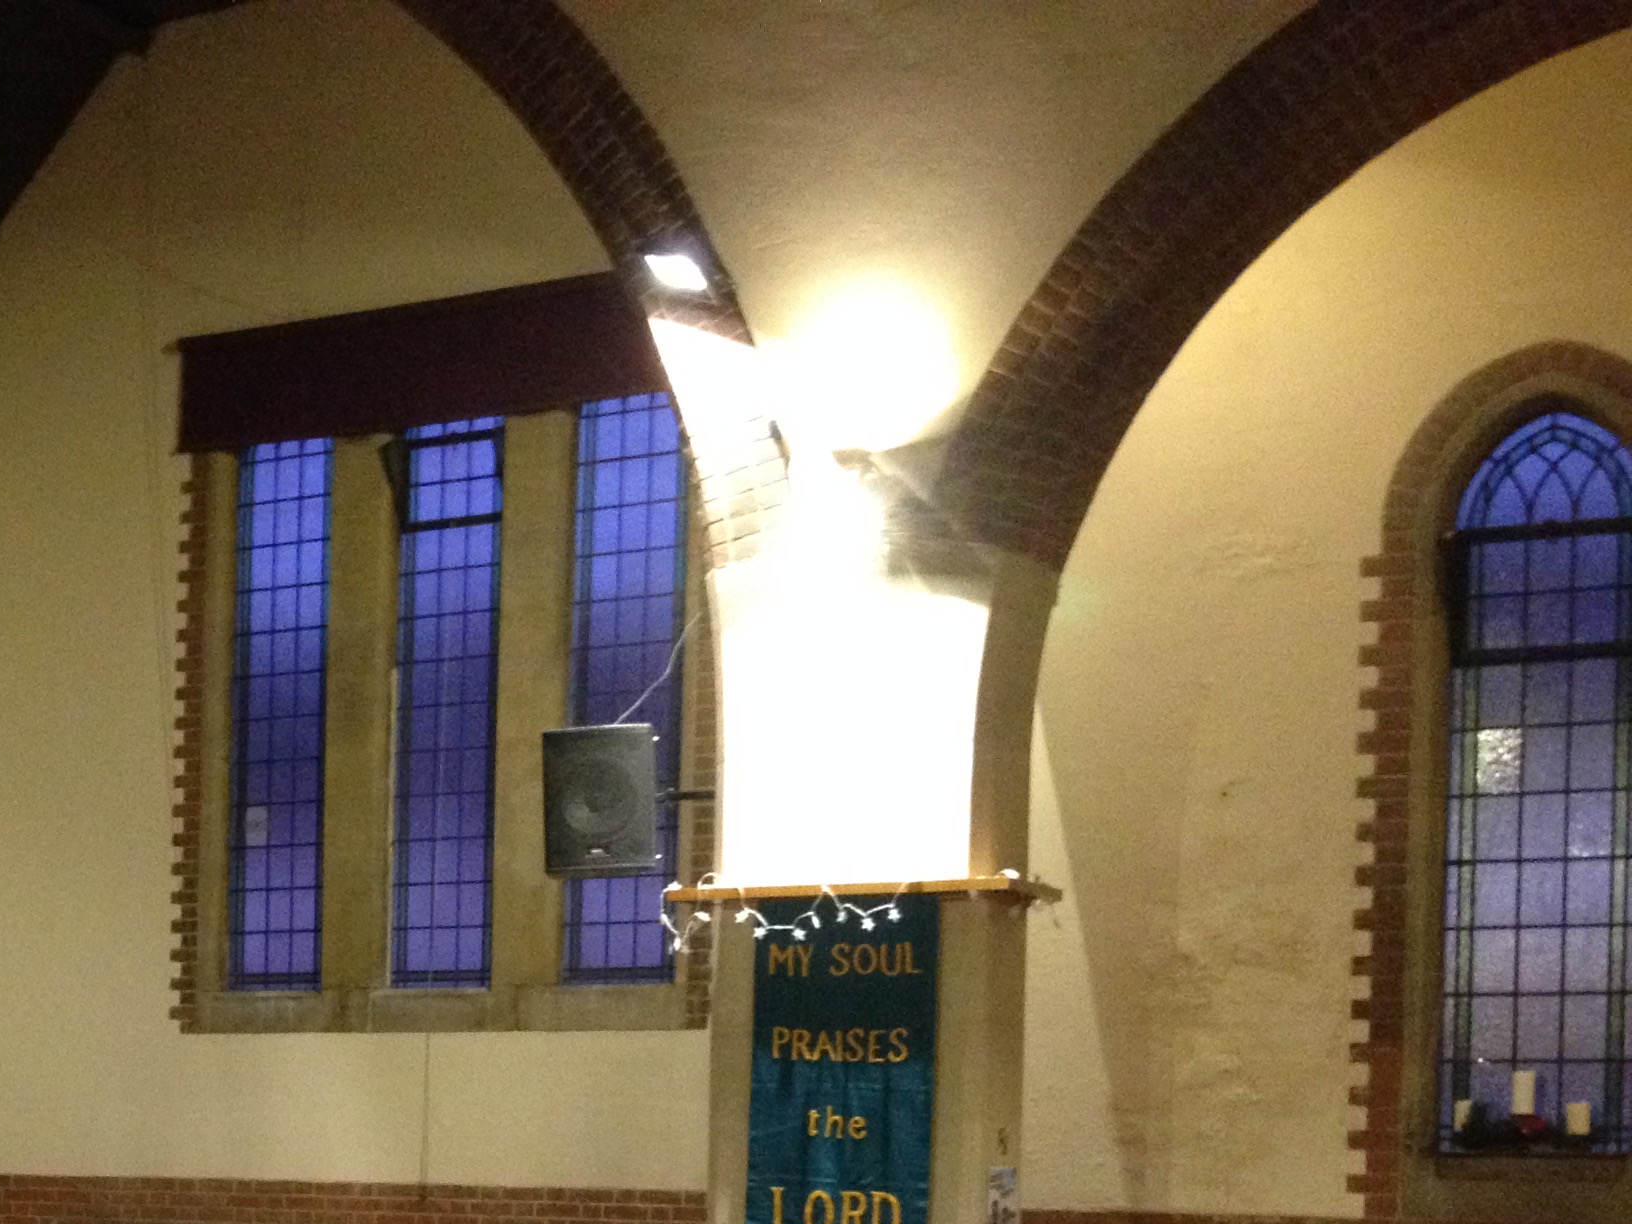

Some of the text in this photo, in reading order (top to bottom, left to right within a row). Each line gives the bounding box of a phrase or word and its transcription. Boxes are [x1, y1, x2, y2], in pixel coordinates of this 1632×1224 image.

[768, 941, 923, 977] MY SOUL
[772, 1026, 909, 1063] PRAISES
[807, 1105, 868, 1140] the
